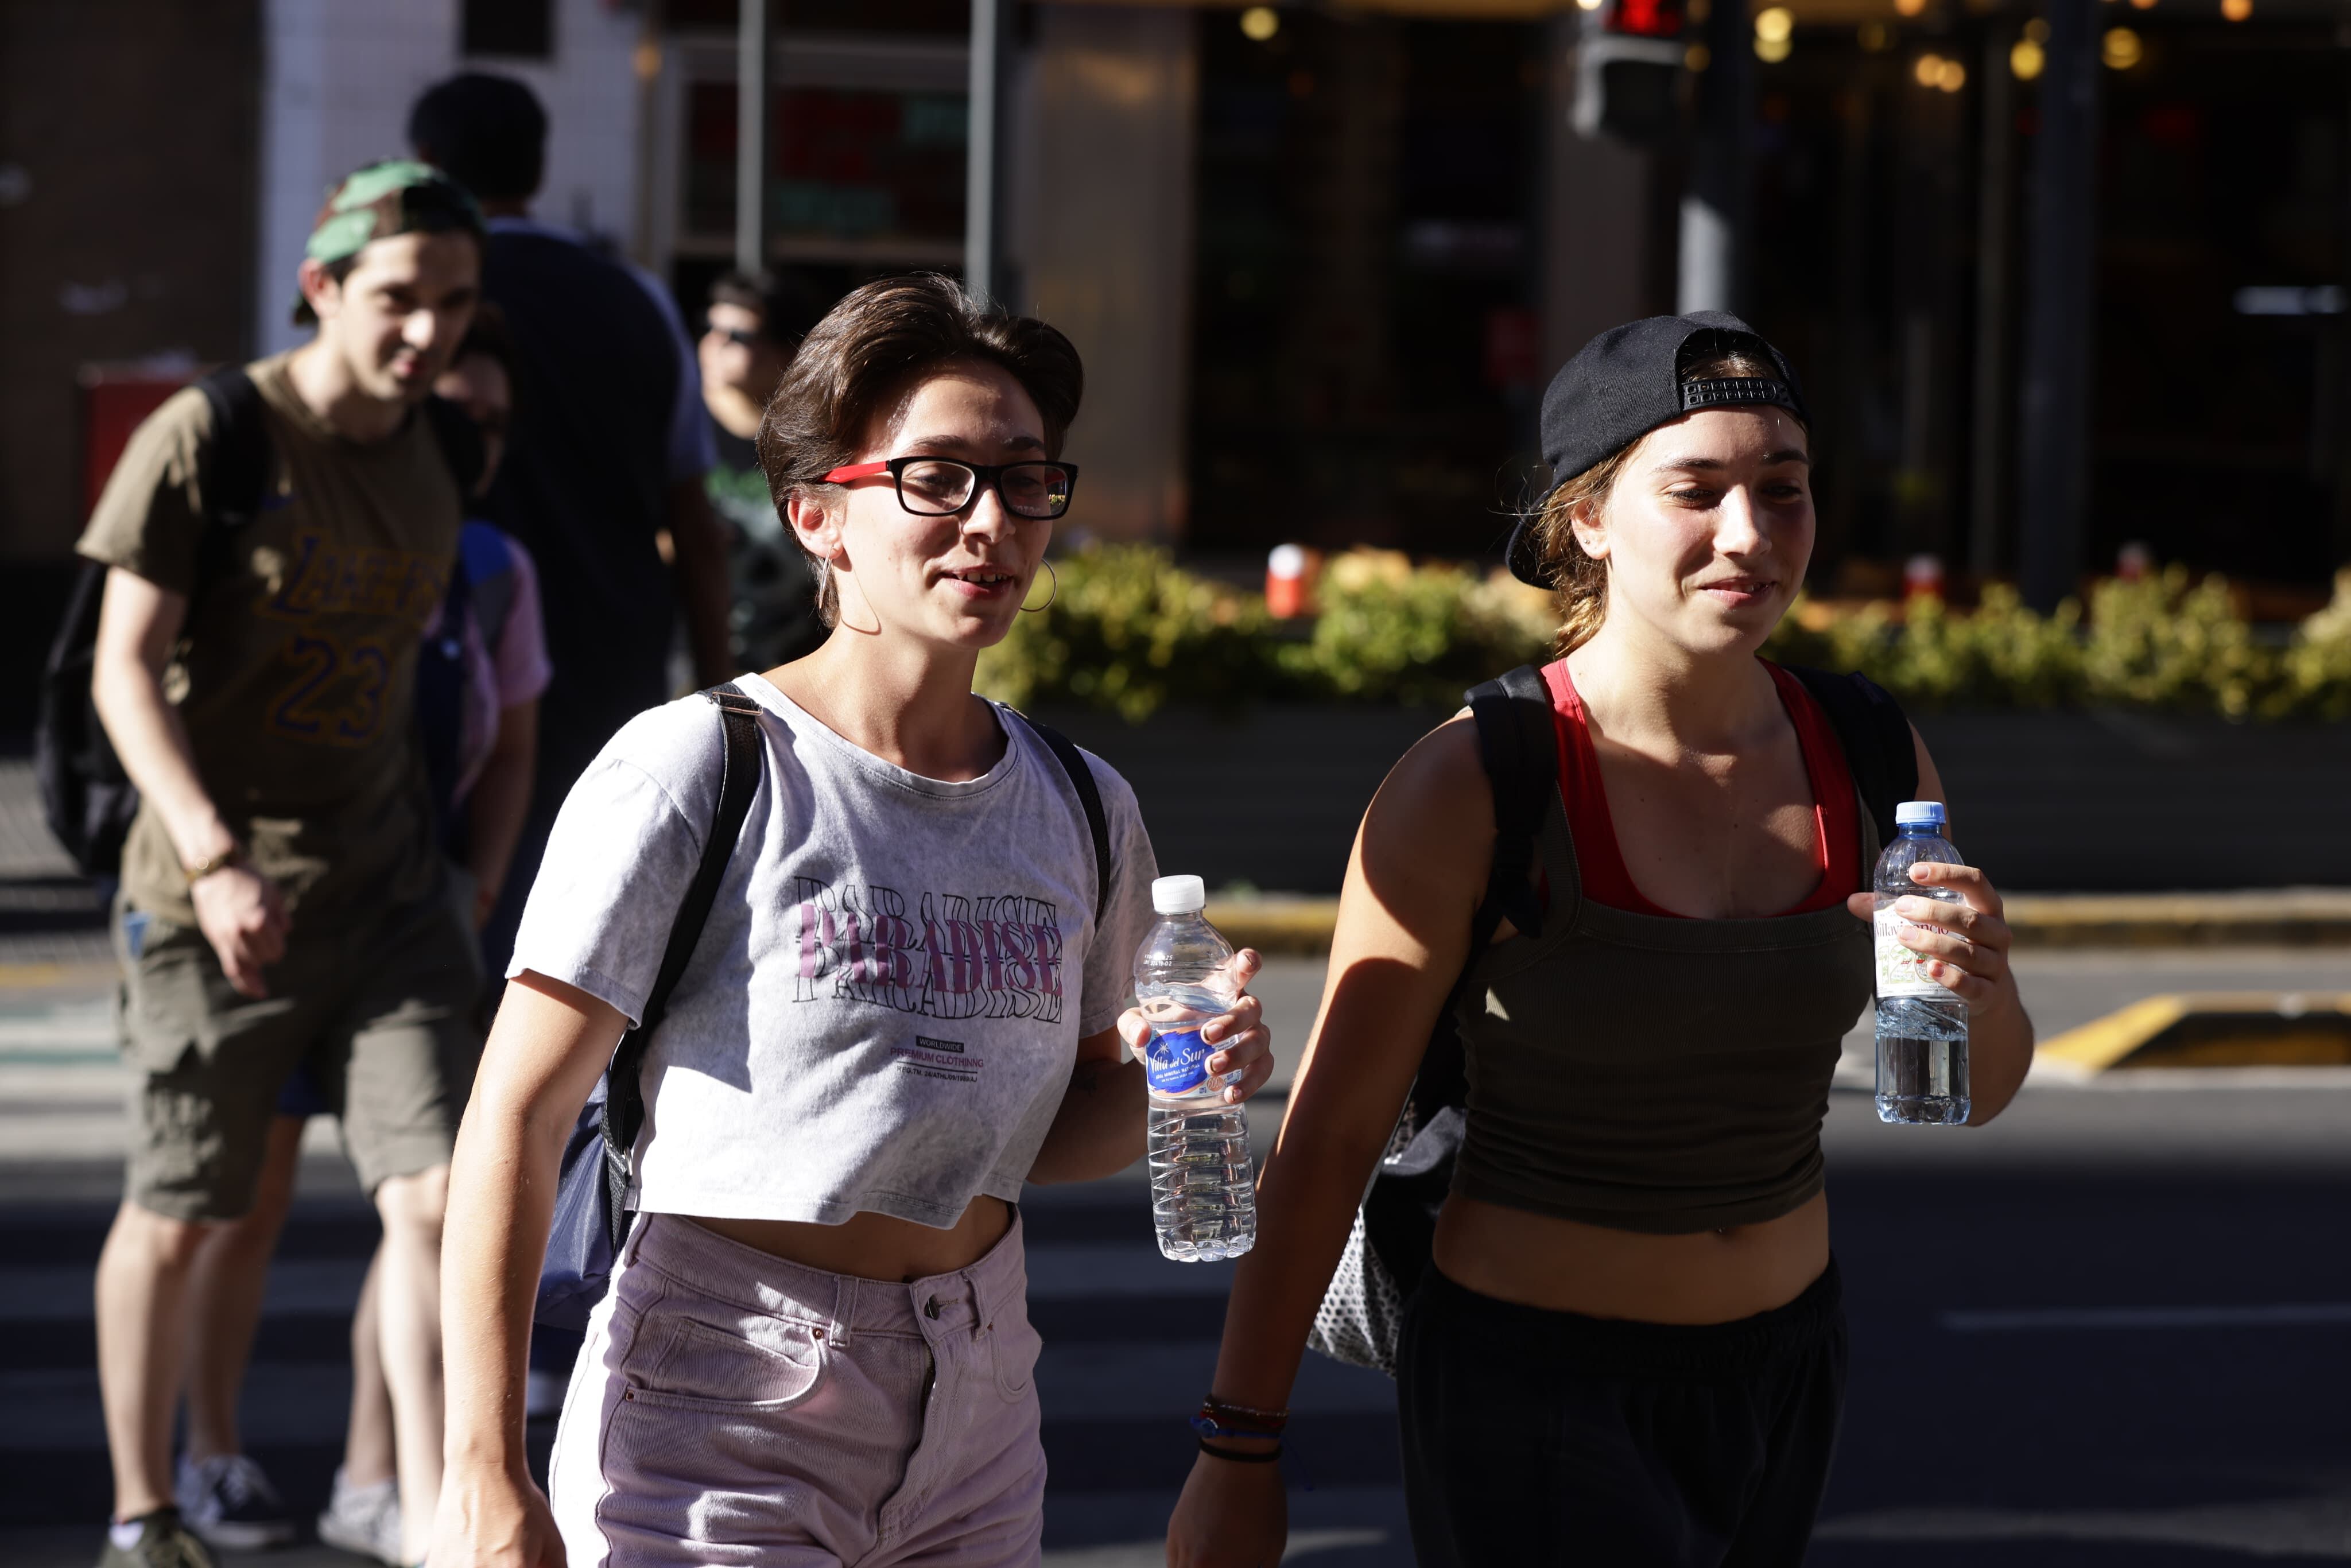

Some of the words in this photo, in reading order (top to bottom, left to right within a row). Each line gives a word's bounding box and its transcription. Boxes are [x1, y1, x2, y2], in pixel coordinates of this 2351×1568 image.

[264, 631, 393, 745] 23
[1875, 921, 1949, 937] Villavncio
[796, 903, 1063, 997] PARADISE
[920, 1037, 962, 1052] WORLDWIDE
[890, 1047, 934, 1062] PREMIUM
[936, 1054, 984, 1068] CLOTHINNG
[1149, 1056, 1168, 1074] Villa
[1170, 1057, 1180, 1069] del
[1180, 1047, 1205, 1065] Sur
[1163, 1069, 1181, 1077] MINERAL
[1181, 1063, 1200, 1073] NATURAL
